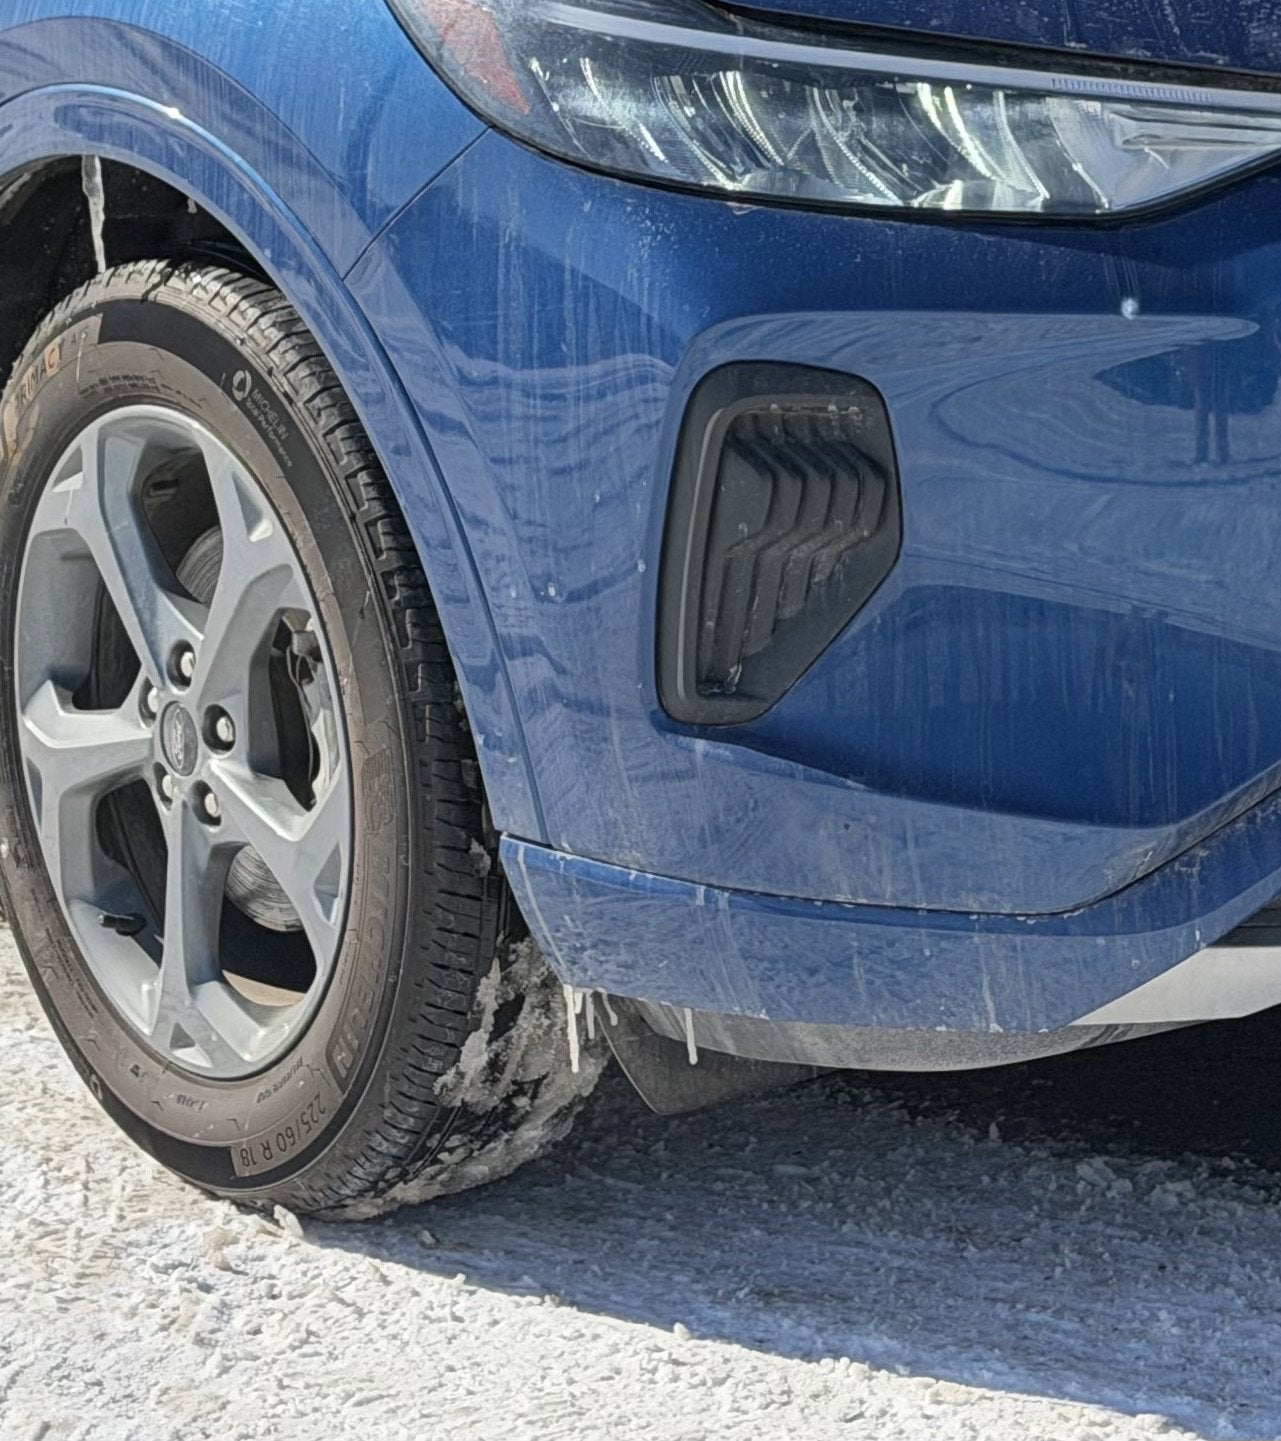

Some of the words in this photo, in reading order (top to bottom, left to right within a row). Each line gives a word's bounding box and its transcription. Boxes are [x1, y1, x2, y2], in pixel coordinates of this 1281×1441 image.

[251, 388, 289, 440] MICHELIN
[258, 414, 293, 467] Performance
[276, 1093, 327, 1152] 225/60
[240, 1146, 257, 1167] 18
[260, 1140, 273, 1161] R
